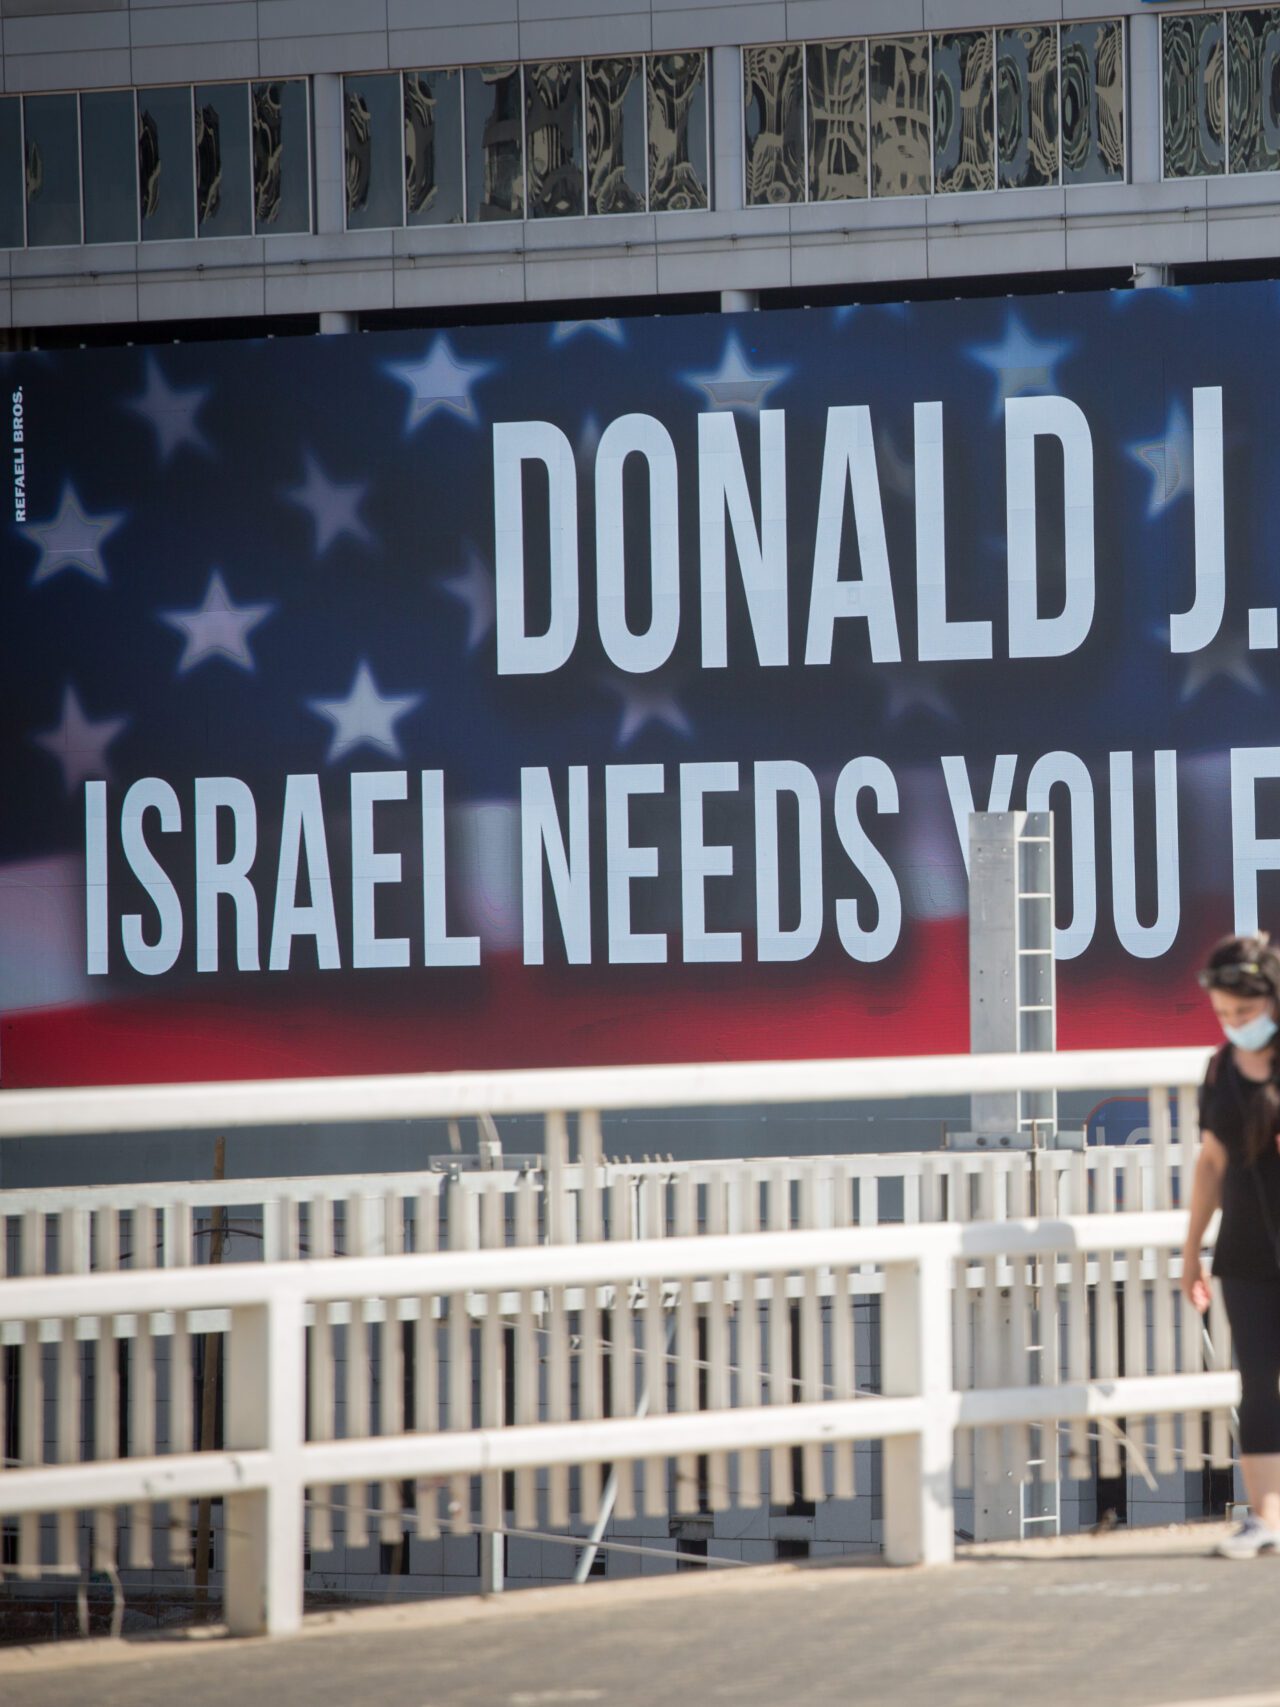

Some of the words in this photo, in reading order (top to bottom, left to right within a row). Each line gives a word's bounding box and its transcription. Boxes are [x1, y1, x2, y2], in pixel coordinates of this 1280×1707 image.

[12, 385, 24, 442] BROS.
[14, 448, 26, 522] REFAELI
[493, 396, 1096, 675] DONALD
[1170, 386, 1279, 653] J.
[85, 770, 481, 976] ISRAEL
[520, 756, 902, 966] NEEDS
